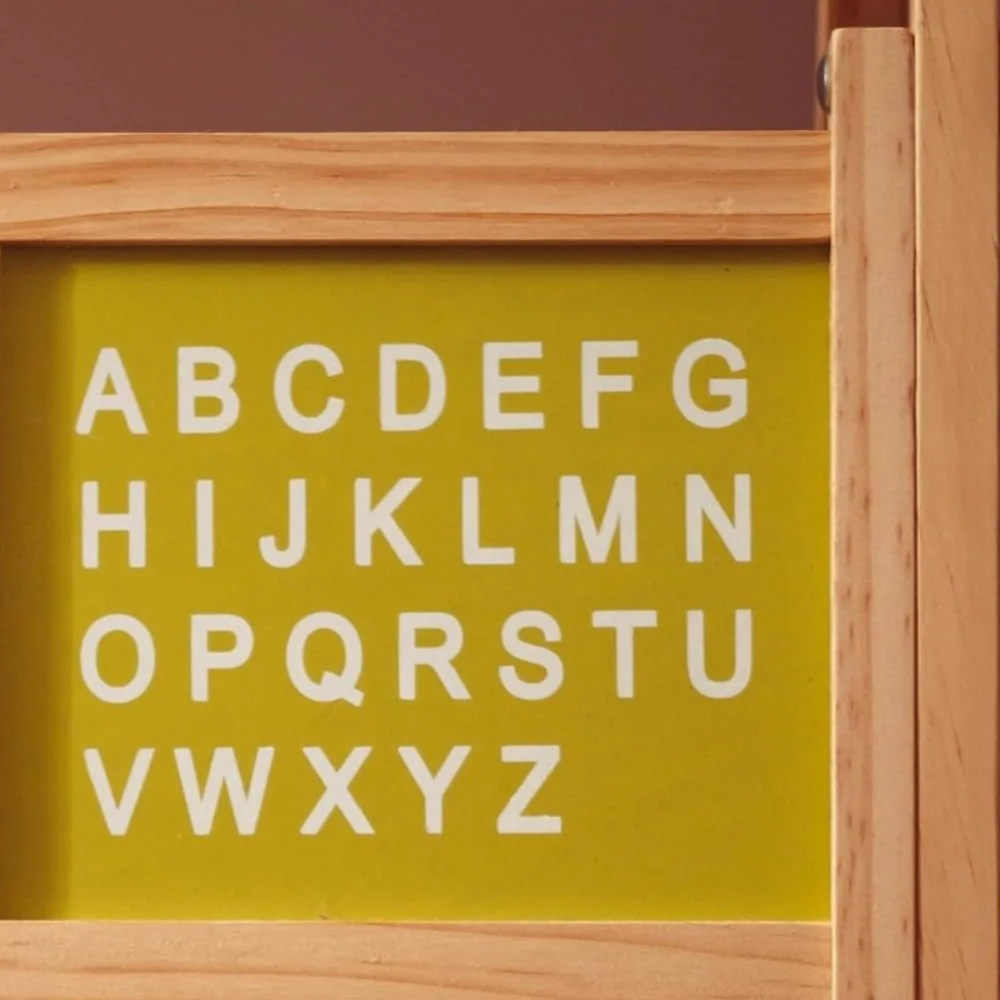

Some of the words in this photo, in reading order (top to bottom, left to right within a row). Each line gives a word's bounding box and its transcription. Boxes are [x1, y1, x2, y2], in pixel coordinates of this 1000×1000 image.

[75, 347, 148, 435] A
[177, 346, 241, 434] B
[273, 343, 345, 434] C
[379, 343, 447, 432] D
[482, 341, 545, 430] E
[581, 340, 638, 429] F
[672, 338, 748, 429] G
[81, 480, 147, 569] H
[259, 478, 307, 569] J
[354, 477, 423, 567] K
[461, 476, 516, 565] L
[558, 474, 637, 564] M
[685, 473, 752, 563] N
[79, 613, 156, 704] O
[190, 613, 254, 702] P
[285, 611, 365, 707] Q
[398, 611, 471, 701] R
[498, 609, 564, 701] S
[592, 609, 658, 699] T
[686, 609, 753, 699] U
[83, 747, 155, 836] V
[173, 746, 275, 836] W
[300, 745, 375, 836] X
[397, 745, 471, 834] Y
[497, 744, 562, 834] Z
